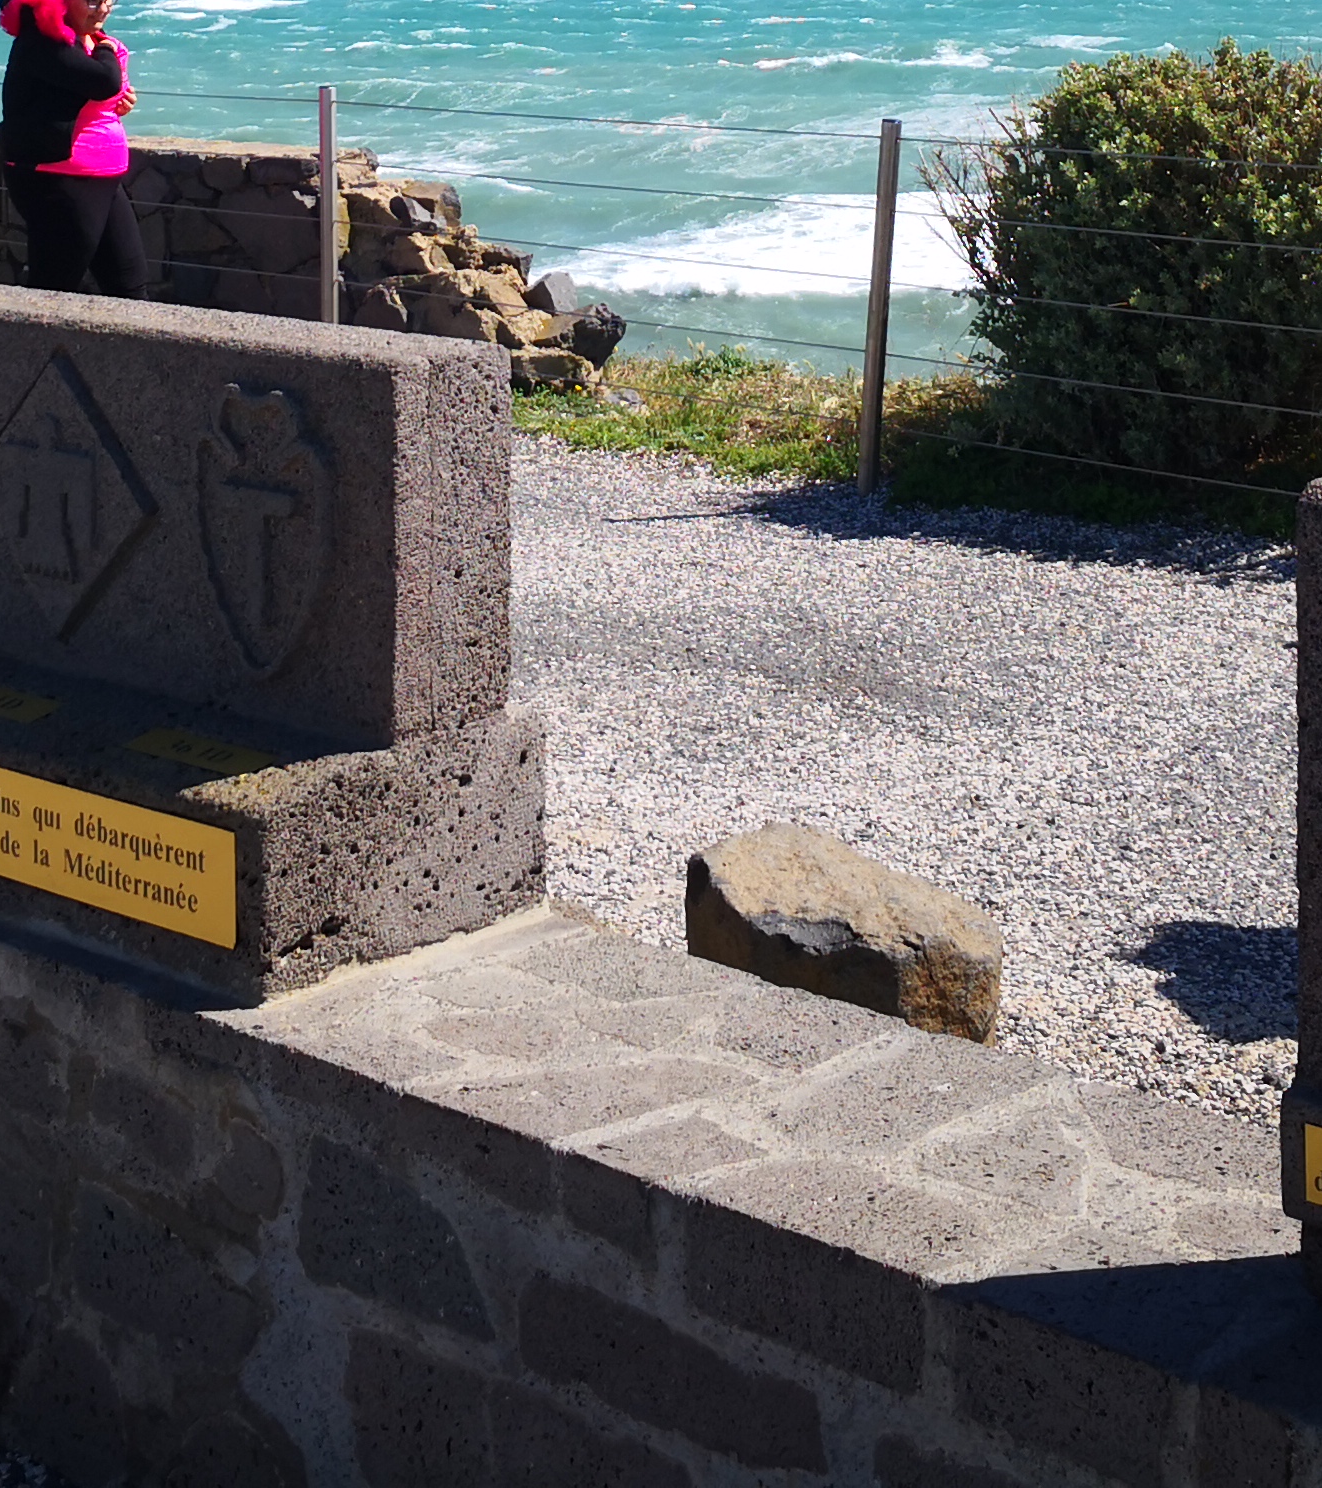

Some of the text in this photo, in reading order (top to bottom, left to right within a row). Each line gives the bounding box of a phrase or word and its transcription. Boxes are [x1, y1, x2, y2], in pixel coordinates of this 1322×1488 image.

[0, 830, 20, 858] de
[34, 840, 50, 868] la
[64, 849, 198, 913] Méditerranée
[33, 806, 61, 831] qui
[75, 813, 205, 873] débarquèrent
